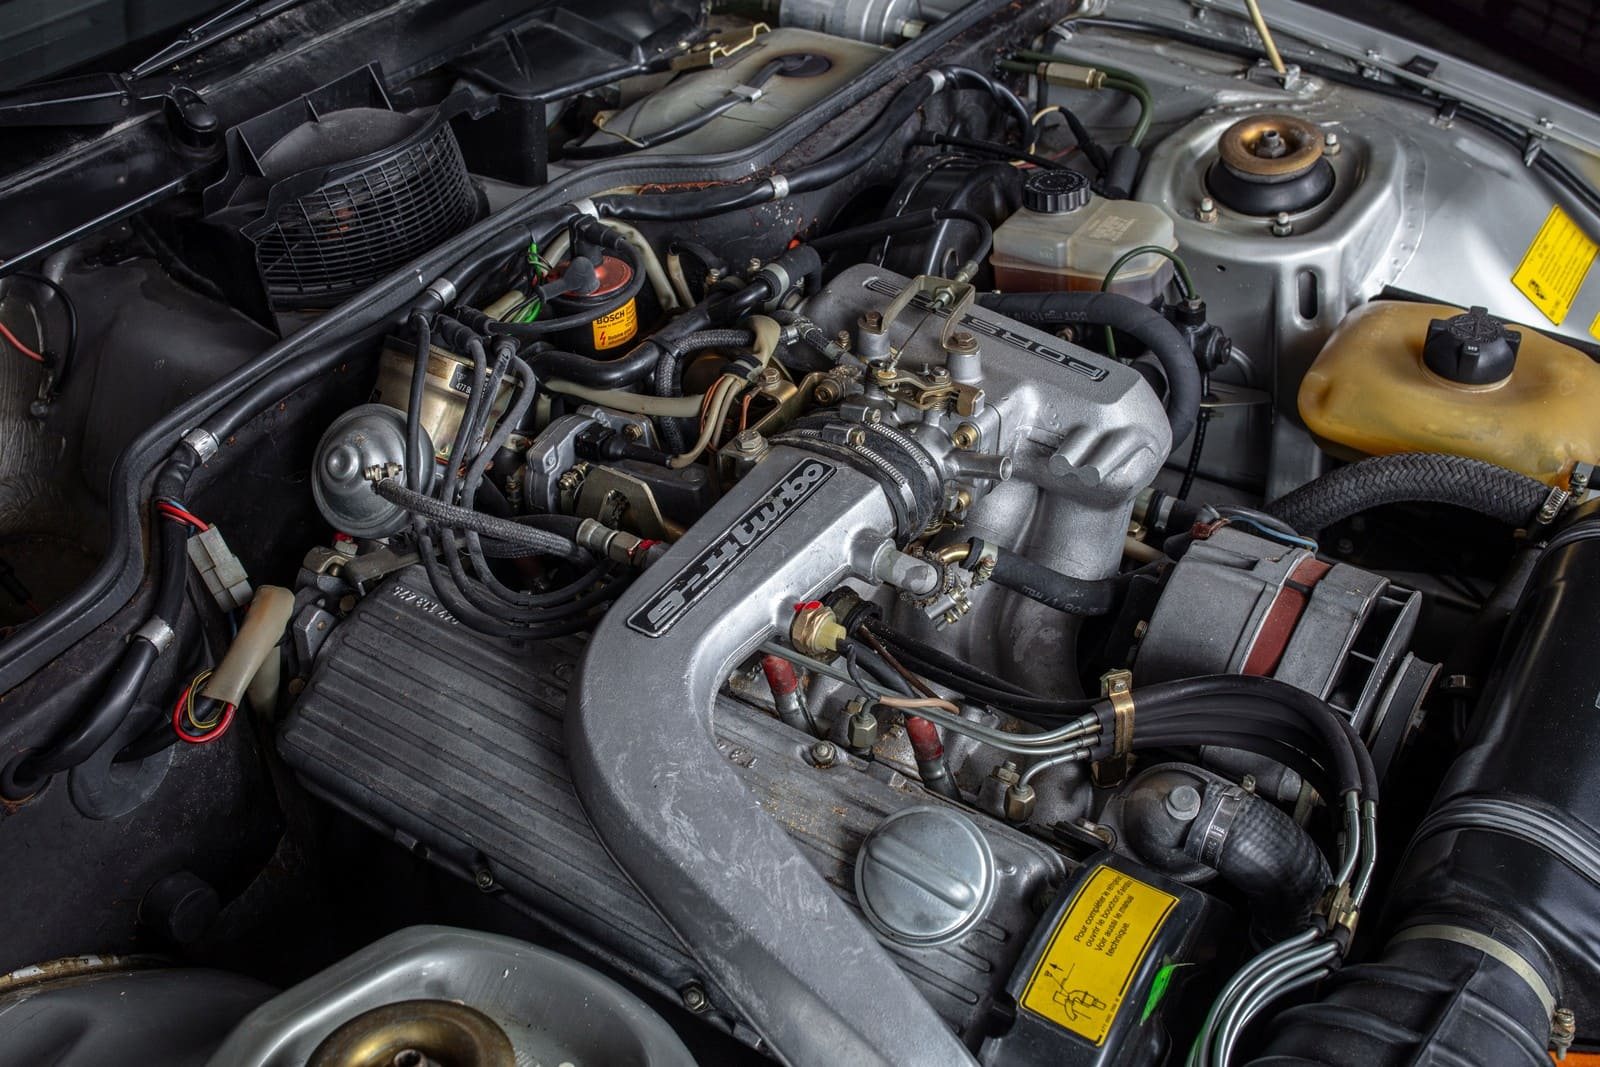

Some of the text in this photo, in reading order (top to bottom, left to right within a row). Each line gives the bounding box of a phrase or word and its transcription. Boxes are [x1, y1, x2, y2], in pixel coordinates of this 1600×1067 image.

[596, 310, 625, 324] BOSCH
[731, 463, 824, 546] turbo
[1073, 925, 1088, 942] Pour
[1086, 926, 1100, 947] ouvrir
[1095, 937, 1107, 951] Voir
[1104, 918, 1118, 937] aussi
